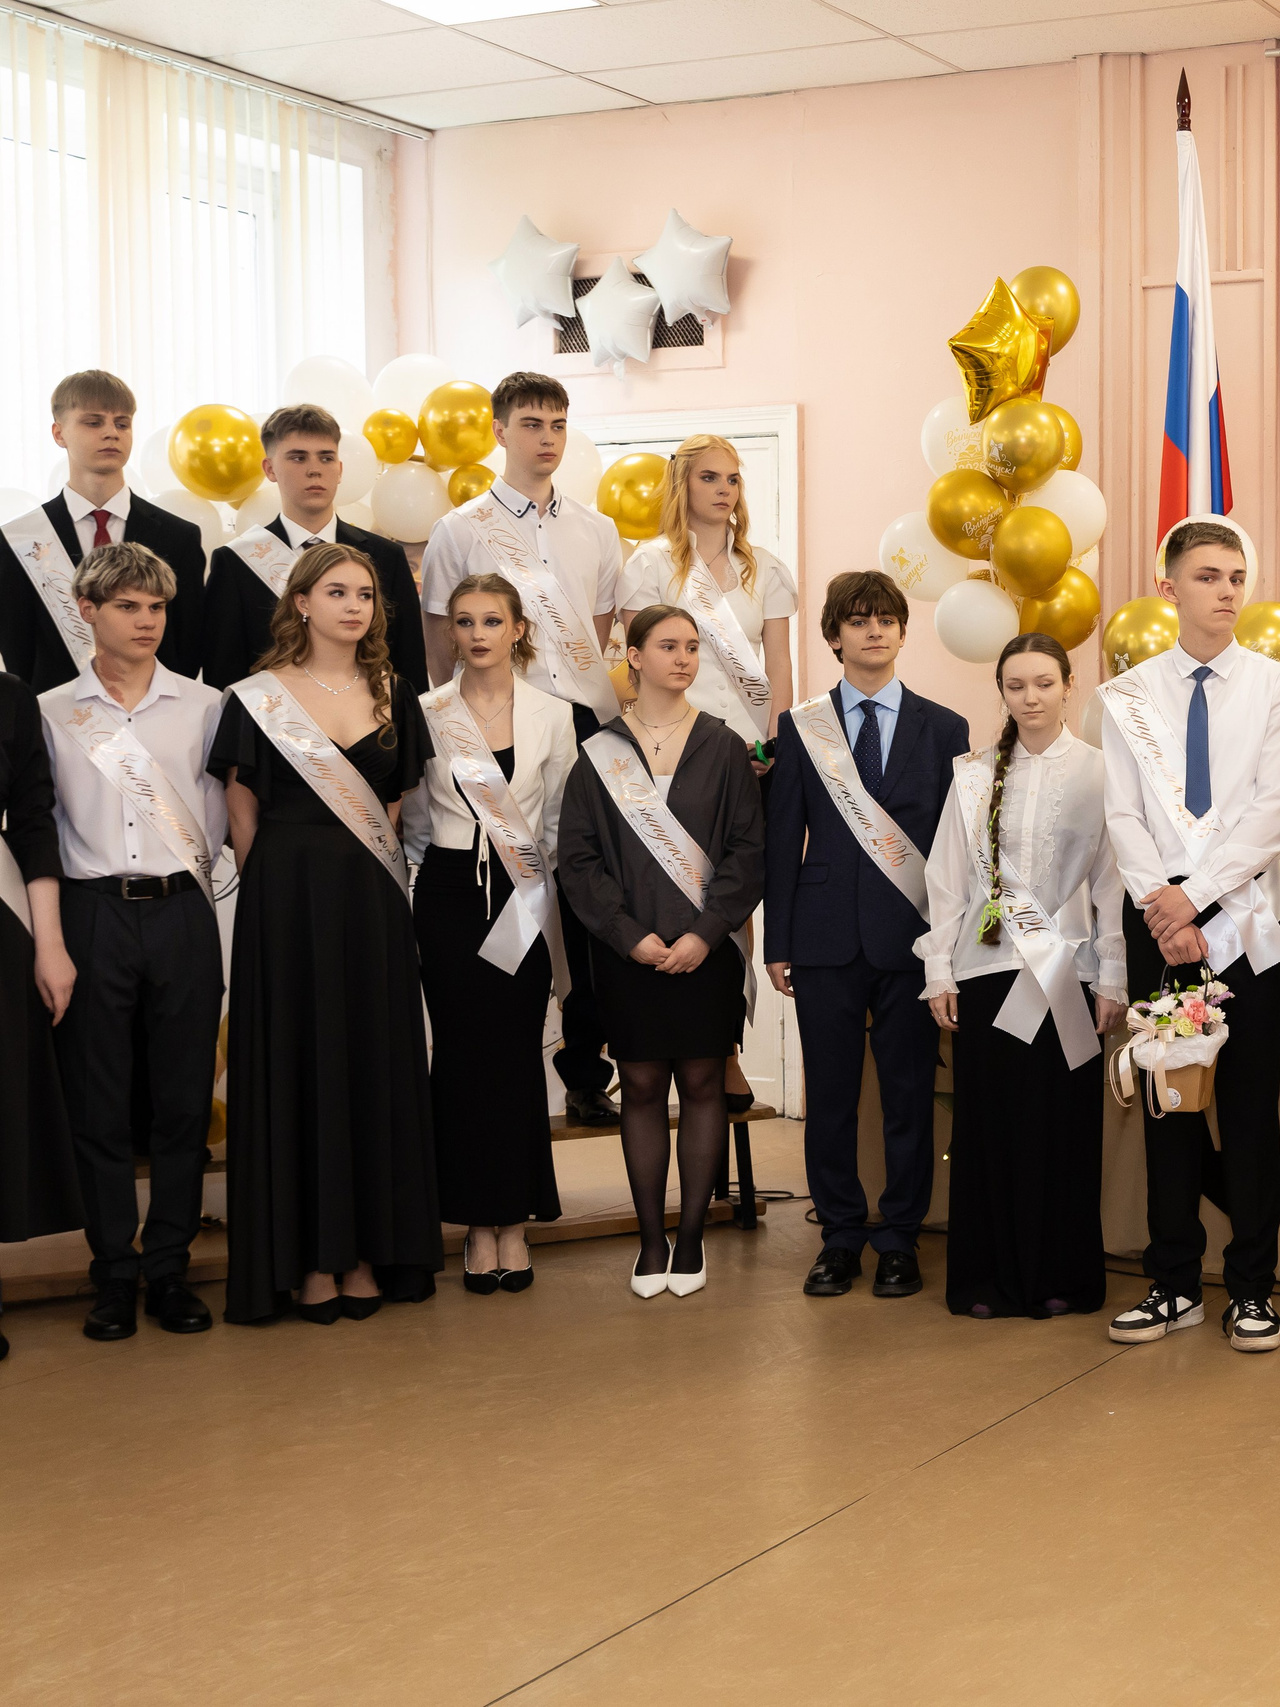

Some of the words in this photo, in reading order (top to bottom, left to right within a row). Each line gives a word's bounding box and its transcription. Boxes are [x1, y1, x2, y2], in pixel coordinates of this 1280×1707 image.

[563, 638, 599, 671] 2026
[736, 674, 772, 707] 2026
[276, 721, 383, 831] Выпускница
[805, 718, 880, 833] Выпускник
[870, 832, 914, 868] 2026
[506, 844, 545, 879] 2026
[1006, 902, 1051, 939] 2026
